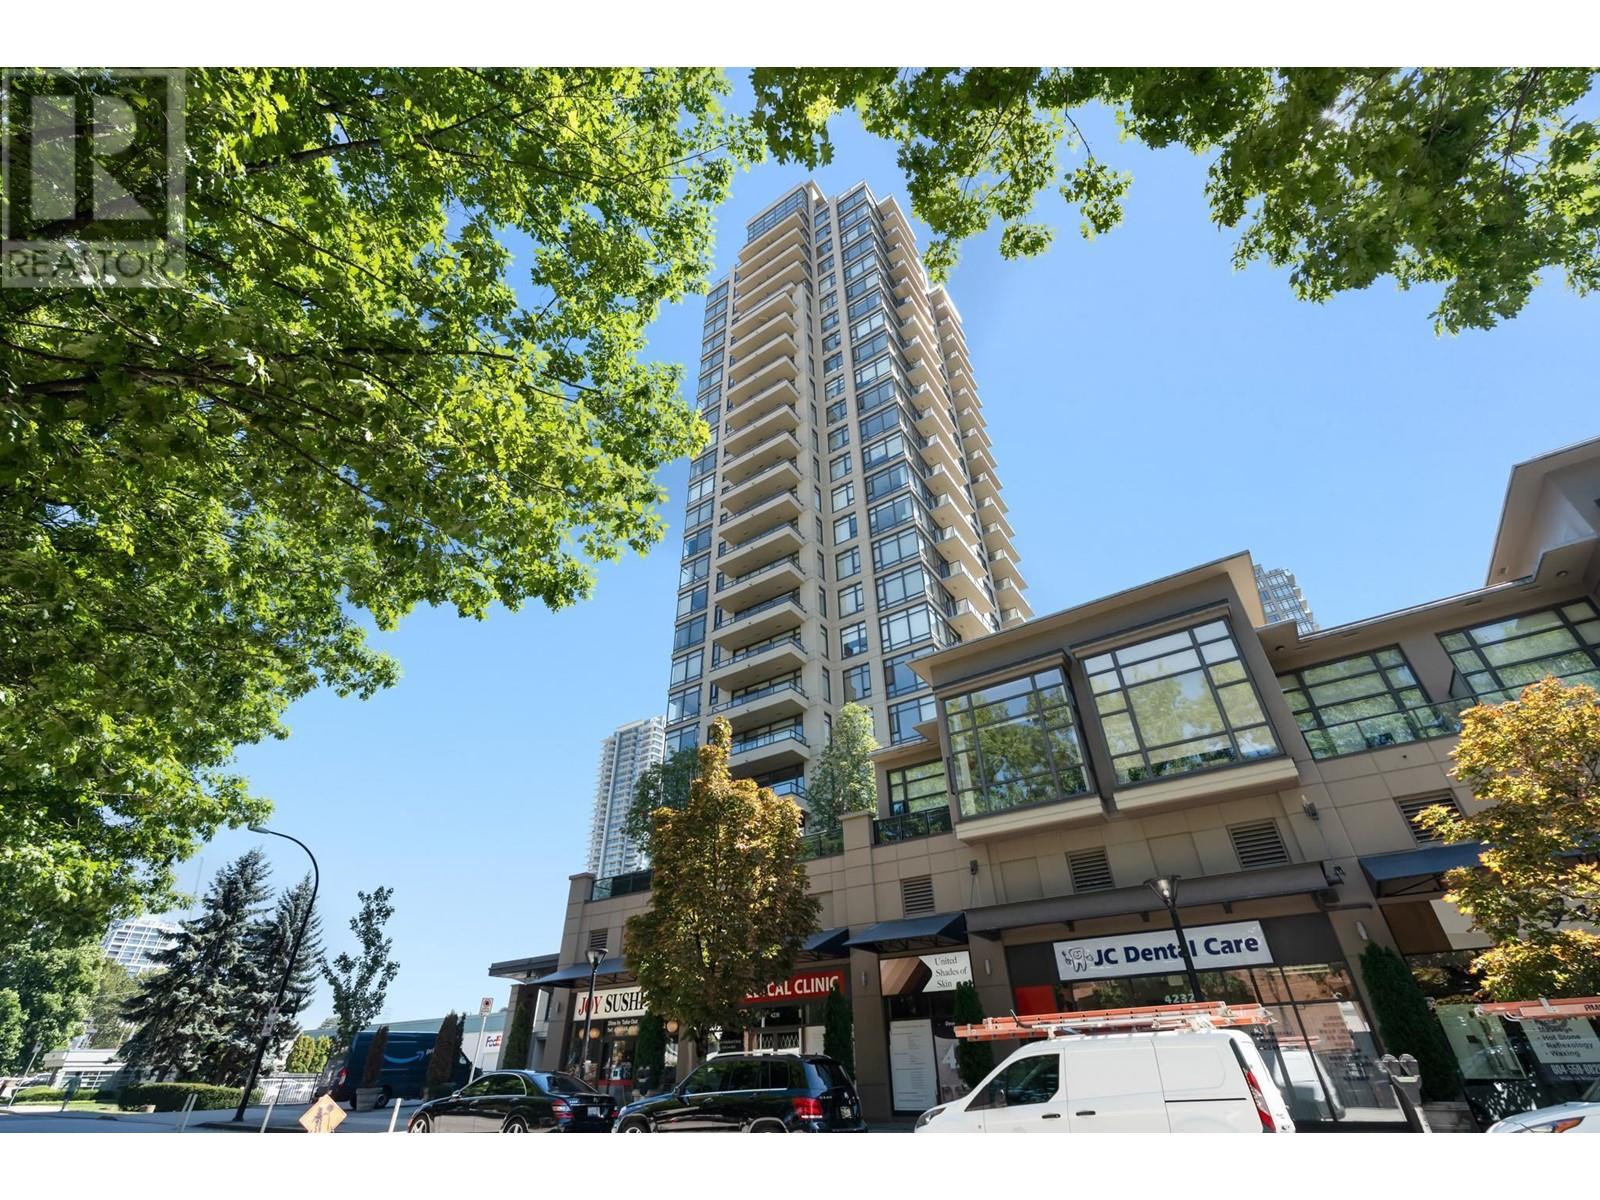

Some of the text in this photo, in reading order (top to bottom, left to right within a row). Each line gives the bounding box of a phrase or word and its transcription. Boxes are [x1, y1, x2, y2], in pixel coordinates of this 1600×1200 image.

[1094, 947, 1118, 966] JC
[1203, 936, 1259, 956] Care
[934, 955, 958, 966] United
[935, 966, 968, 977] Shades of
[794, 976, 839, 995] CLINIC
[936, 980, 953, 989] Skin
[1164, 993, 1196, 1004] 4232
[485, 1035, 502, 1048] FedE
